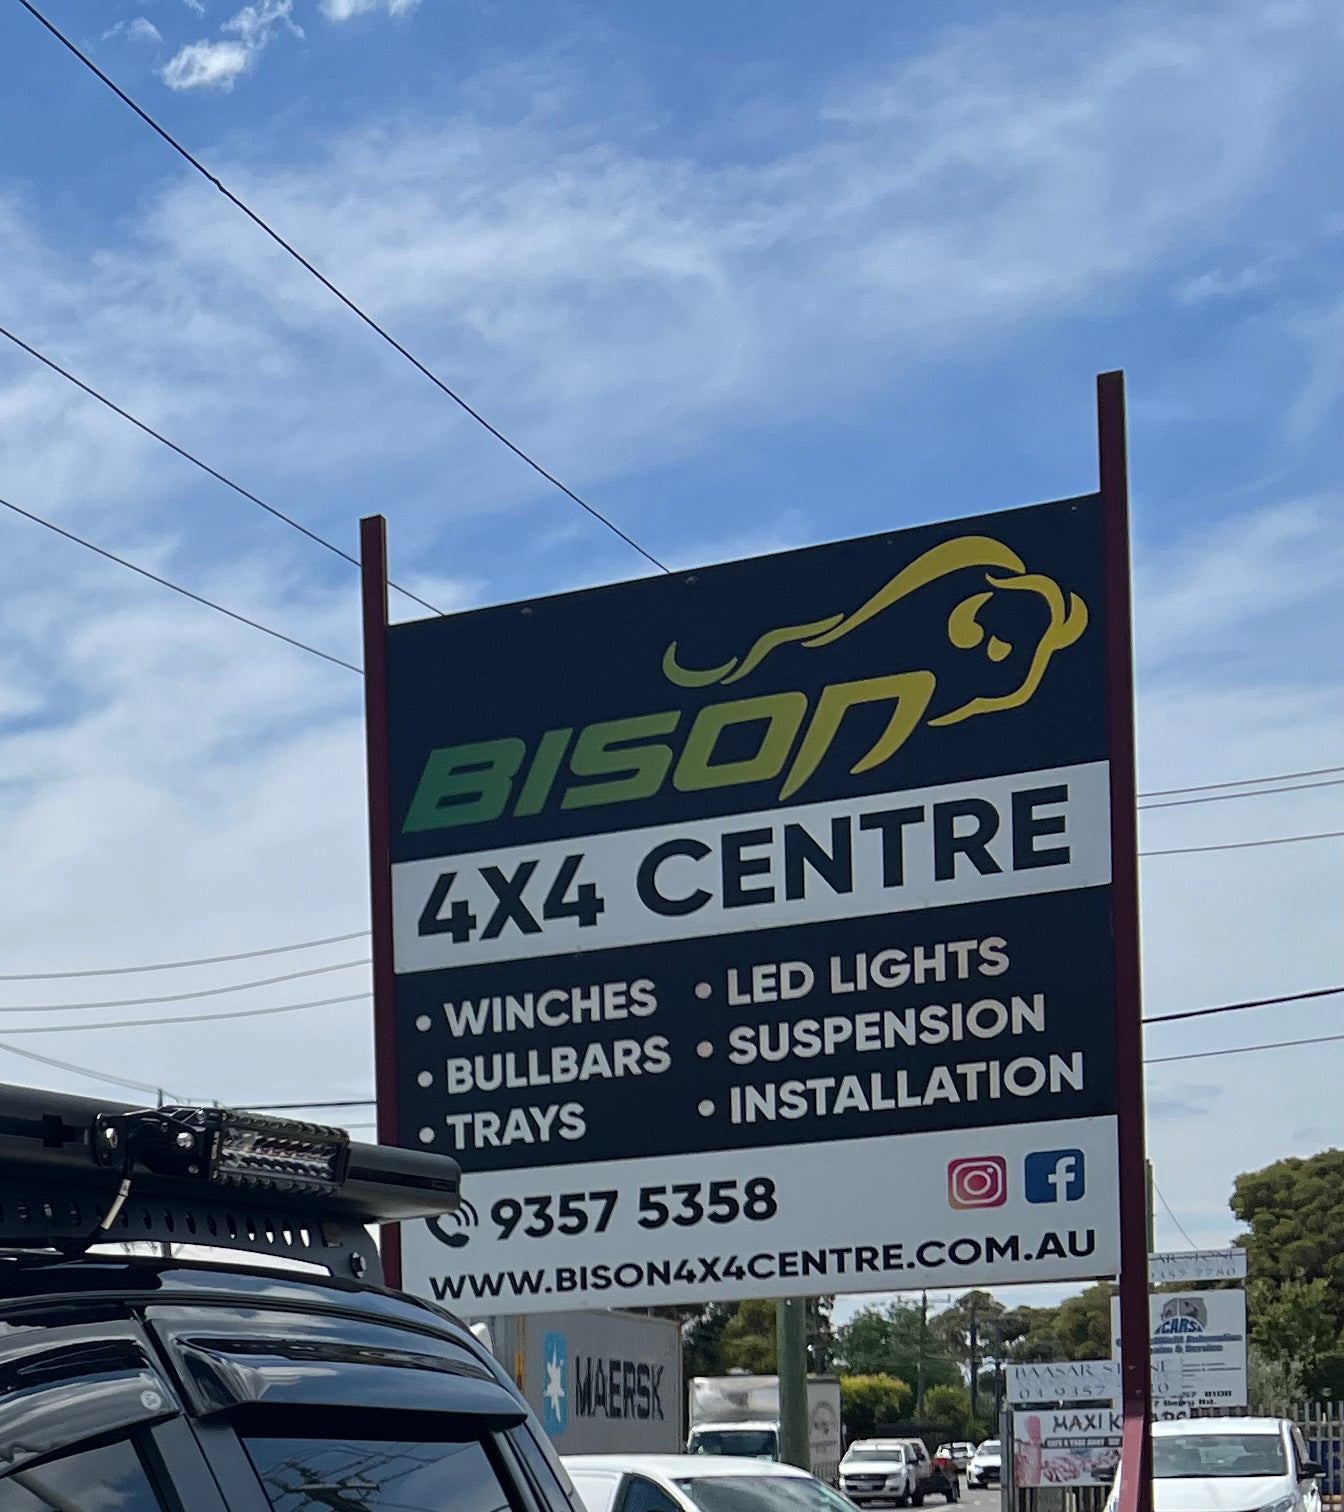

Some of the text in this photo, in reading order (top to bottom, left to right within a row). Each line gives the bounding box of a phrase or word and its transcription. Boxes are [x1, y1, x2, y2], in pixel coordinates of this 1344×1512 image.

[401, 670, 936, 833] BISON
[417, 783, 1072, 943] 4X4 CENTRE
[727, 936, 1010, 1006] LED LIGHTS
[443, 979, 658, 1037] WINCHES
[727, 993, 1047, 1065] SUSPENSION
[446, 1036, 672, 1095] BULLBARS
[730, 1051, 1085, 1125] INSTALLATION
[447, 1102, 586, 1151] TRAYS
[491, 1176, 778, 1240] 9357 5358
[429, 1228, 1097, 1301] WWW.BISON4X4CENTRE.COM.AU
[575, 1355, 665, 1421] MAERSK
[1053, 1411, 1102, 1433] MAXI
